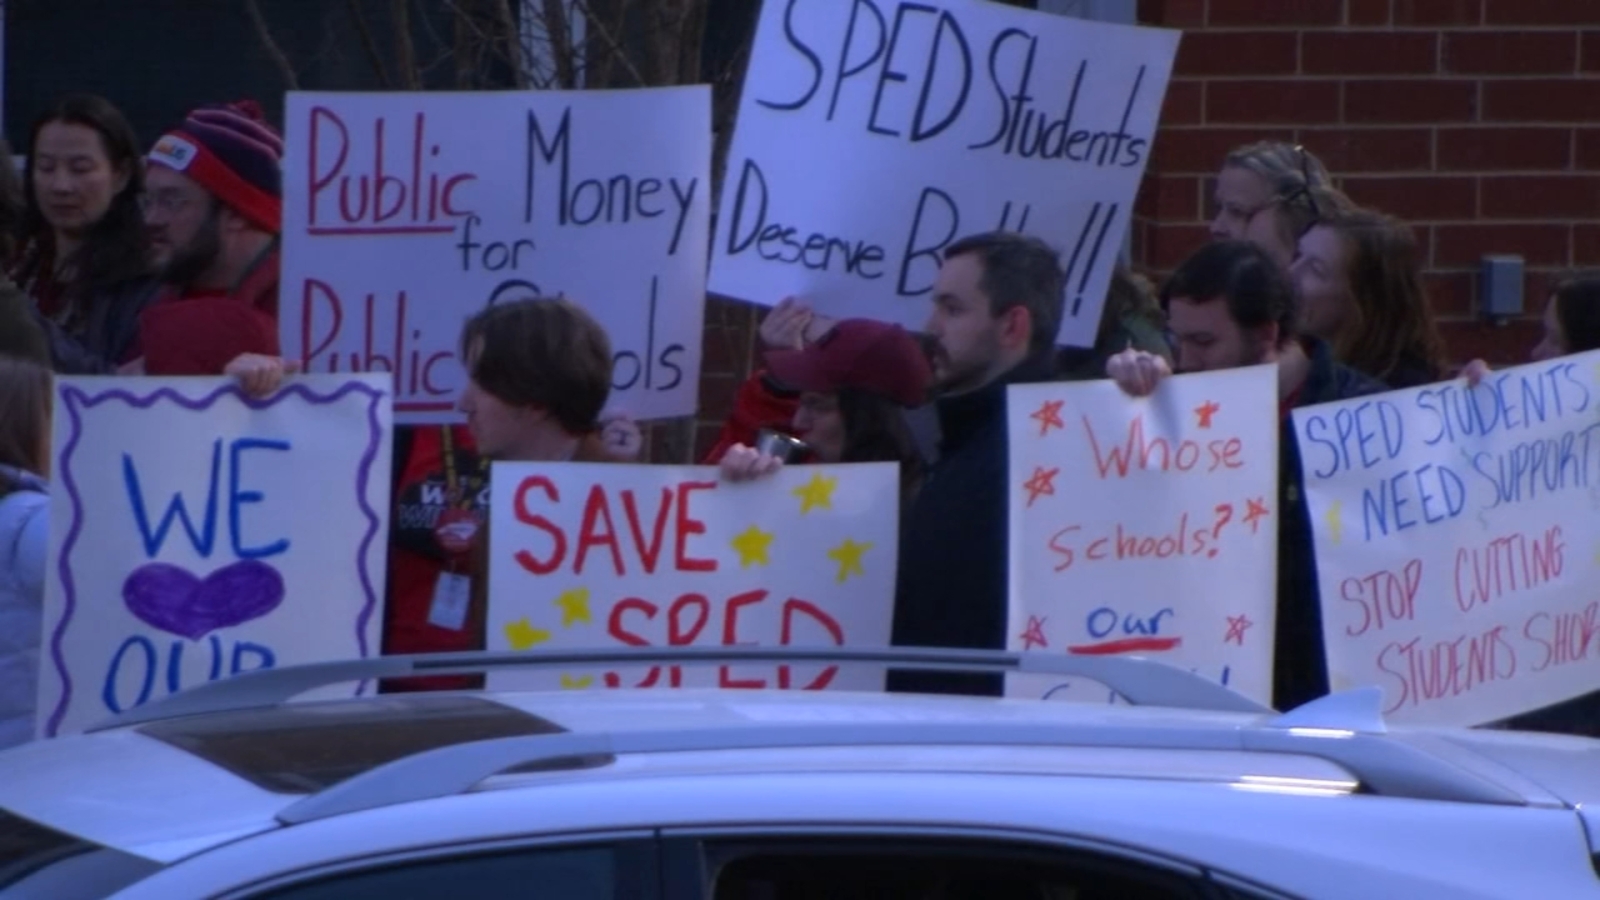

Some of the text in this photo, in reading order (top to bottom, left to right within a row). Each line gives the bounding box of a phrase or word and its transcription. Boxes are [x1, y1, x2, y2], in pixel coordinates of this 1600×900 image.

[755, 0, 1146, 168] SPED Students
[307, 106, 698, 255] Public Money
[727, 158, 884, 279] Deserve
[456, 216, 535, 271] for
[1082, 411, 1245, 480] Whose
[1305, 362, 1590, 479] SPED STUDENTS
[121, 437, 292, 559] WE
[512, 474, 718, 577] SAVE
[1362, 422, 1600, 542] NEED SUPPORT
[1047, 503, 1233, 573] Schools?
[1340, 524, 1566, 637] STOP CUTTING
[603, 588, 844, 690] SPED
[1086, 606, 1174, 639] Our
[1376, 624, 1516, 716] STUDENTS
